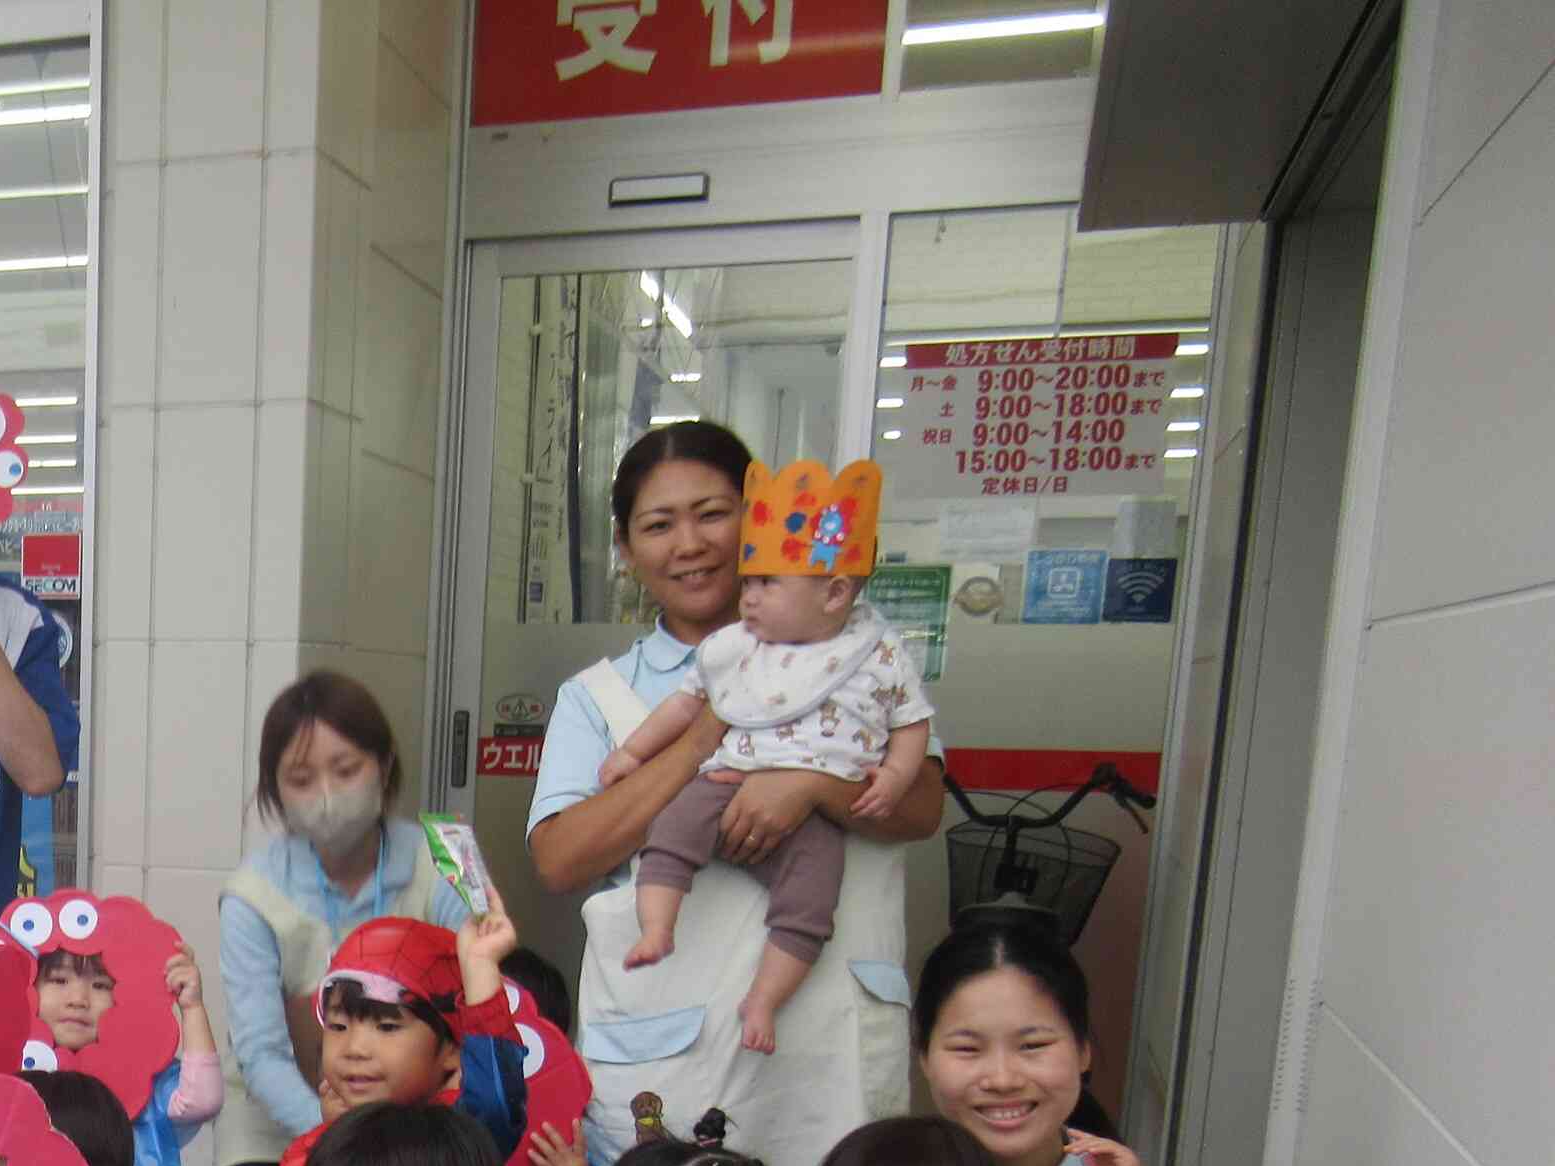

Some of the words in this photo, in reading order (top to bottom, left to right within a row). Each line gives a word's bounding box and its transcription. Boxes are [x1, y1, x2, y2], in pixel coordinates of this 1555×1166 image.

[945, 335, 1137, 366] 処方せん受付時間
[939, 402, 956, 418] 土
[922, 427, 953, 445] 祝日
[971, 419, 1126, 448] 9:00～14:00
[980, 475, 1069, 496] 定休日/日
[24, 578, 77, 594] SECOM
